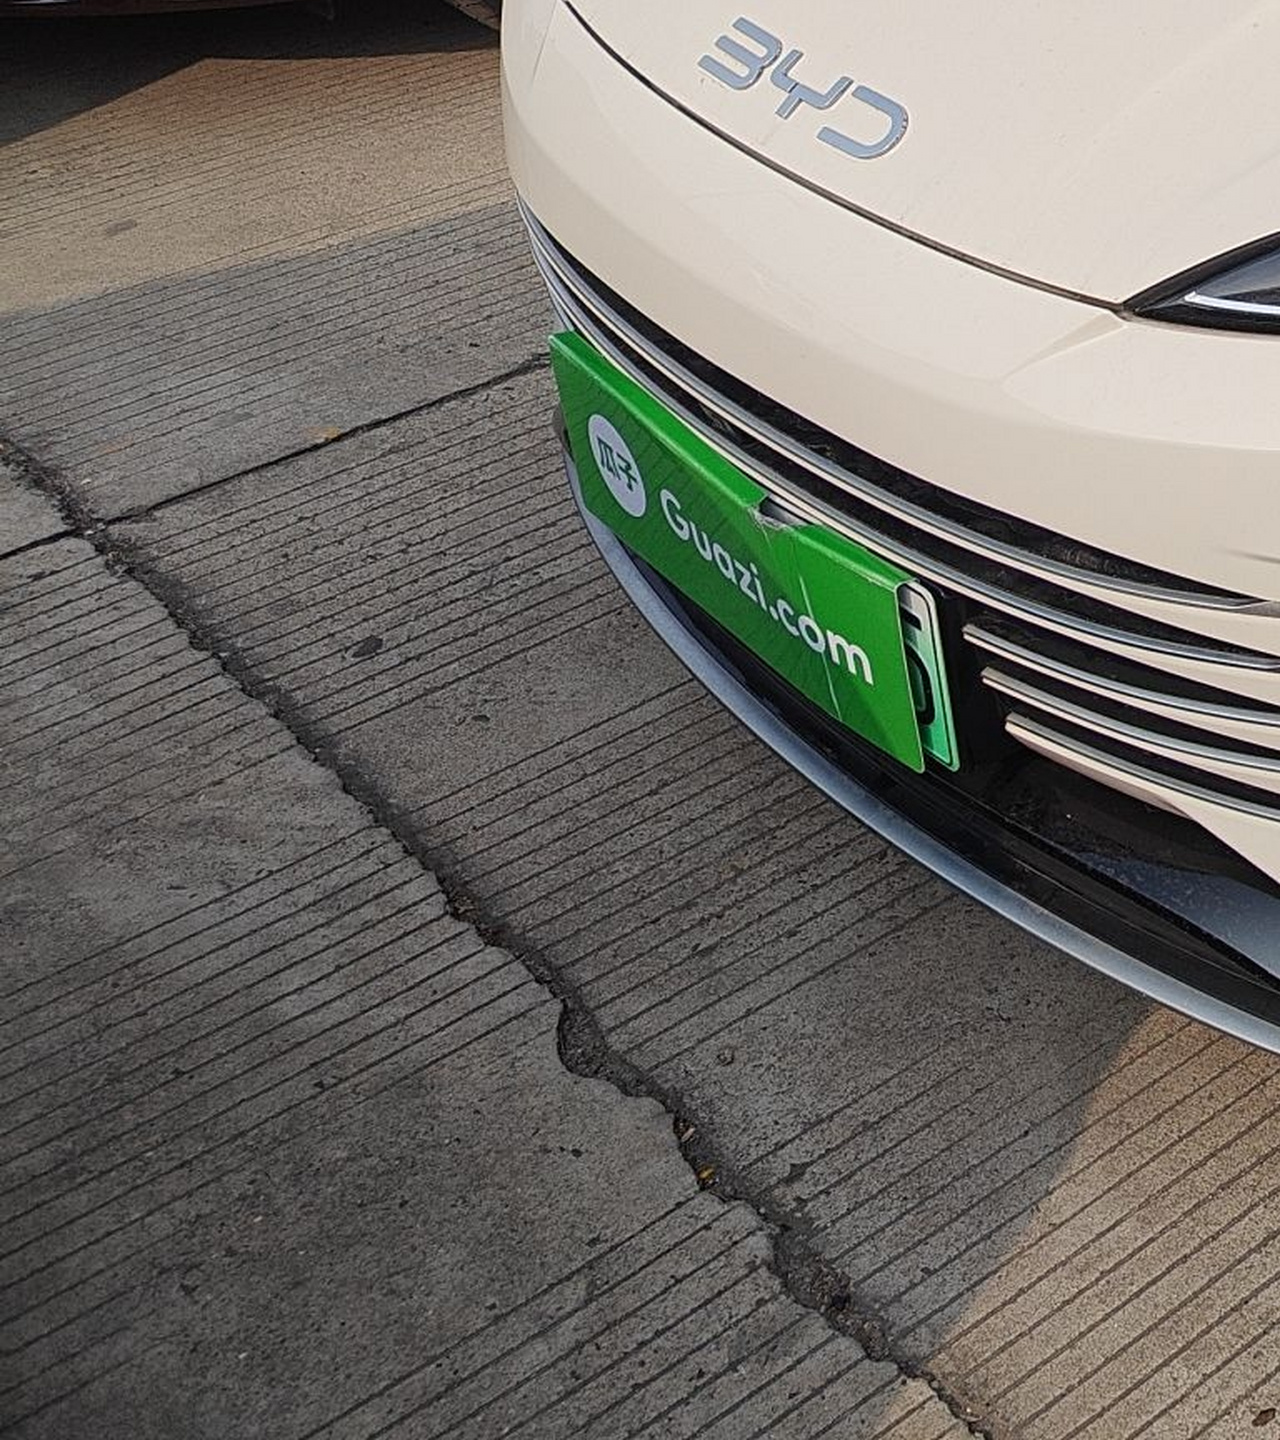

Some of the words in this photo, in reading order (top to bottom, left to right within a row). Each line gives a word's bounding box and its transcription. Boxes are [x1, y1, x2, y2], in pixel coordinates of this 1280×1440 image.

[697, 16, 909, 160] BYD
[596, 436, 639, 493] 瓜子
[660, 489, 875, 686] Guazi.com
